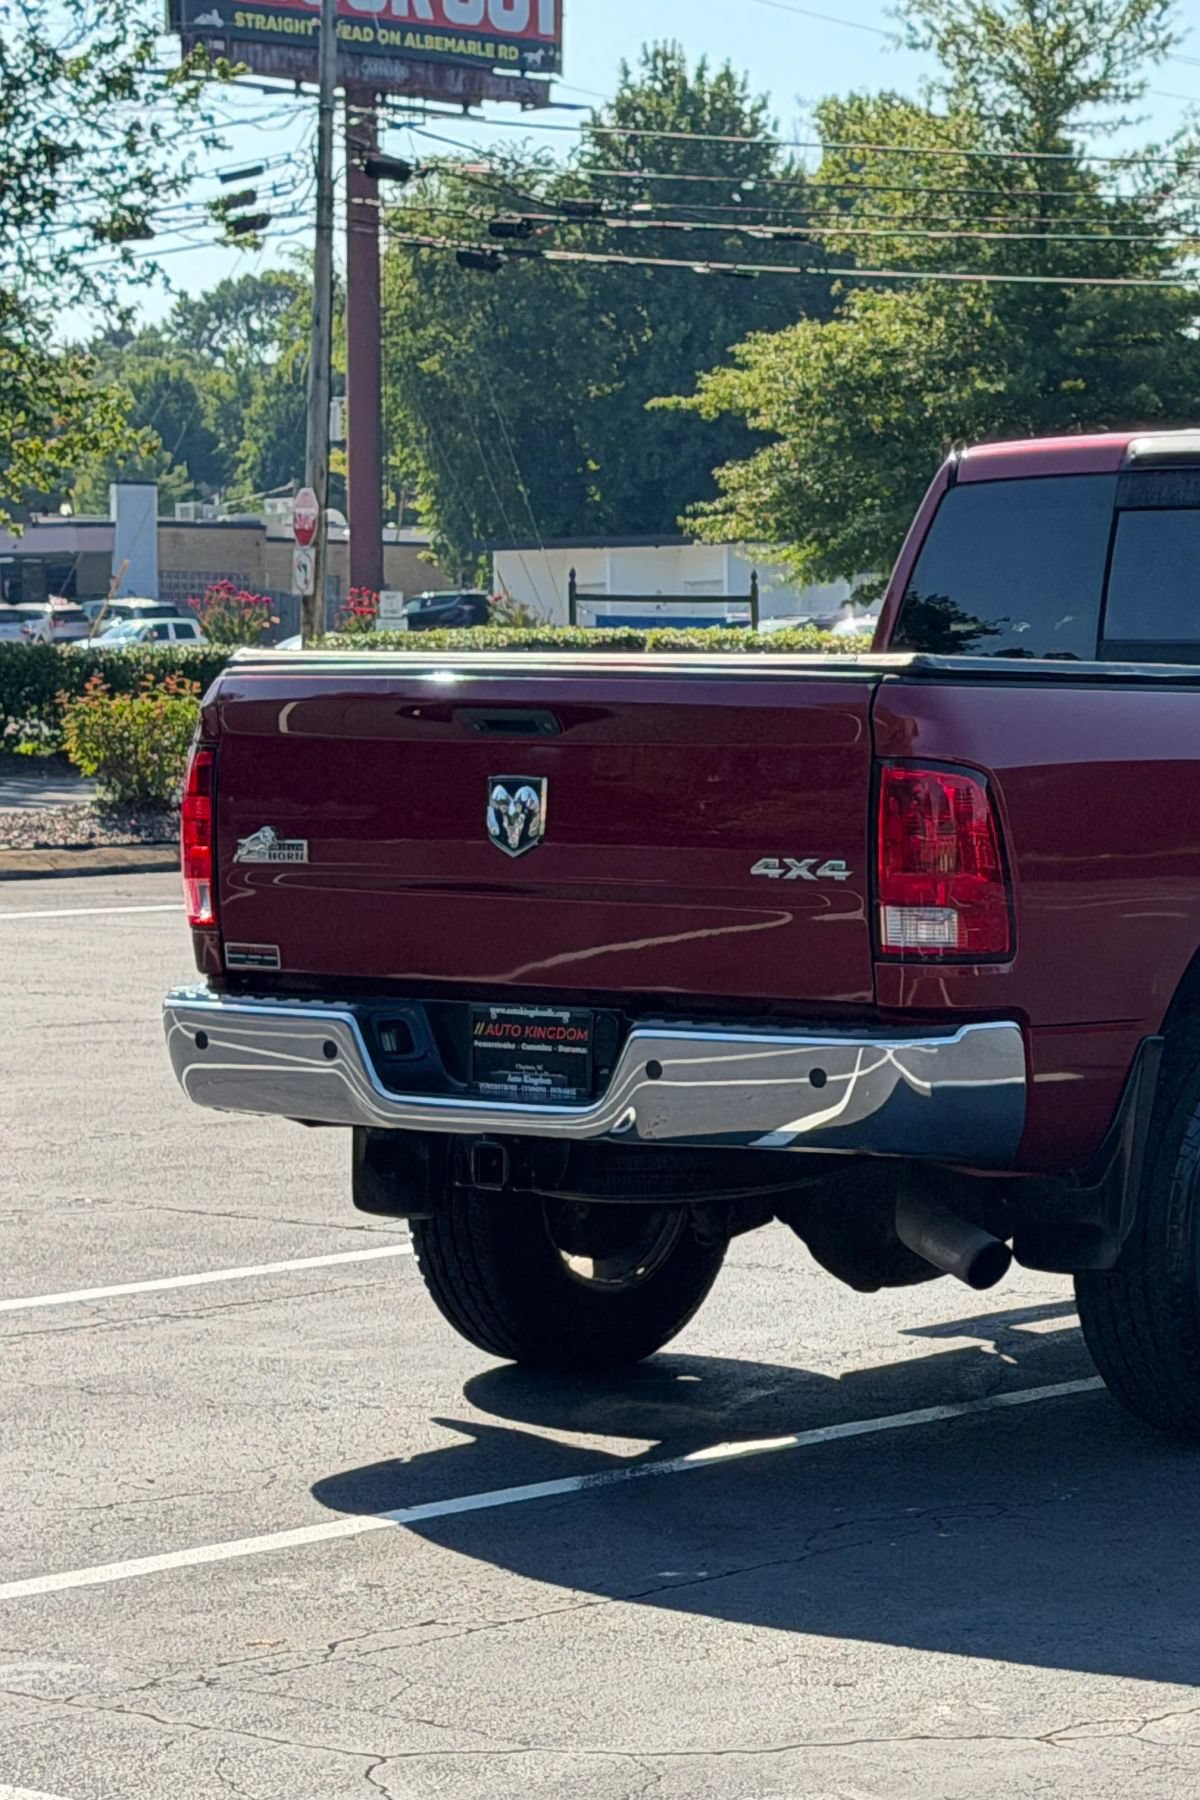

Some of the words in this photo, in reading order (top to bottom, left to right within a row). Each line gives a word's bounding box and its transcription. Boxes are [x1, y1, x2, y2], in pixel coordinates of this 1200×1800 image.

[235, 11, 313, 35] STRAIGHT
[377, 29, 401, 47] ON
[404, 32, 495, 58] ALBEMARLE
[498, 44, 520, 60] RD
[525, 1025, 588, 1041] KINGDOM
